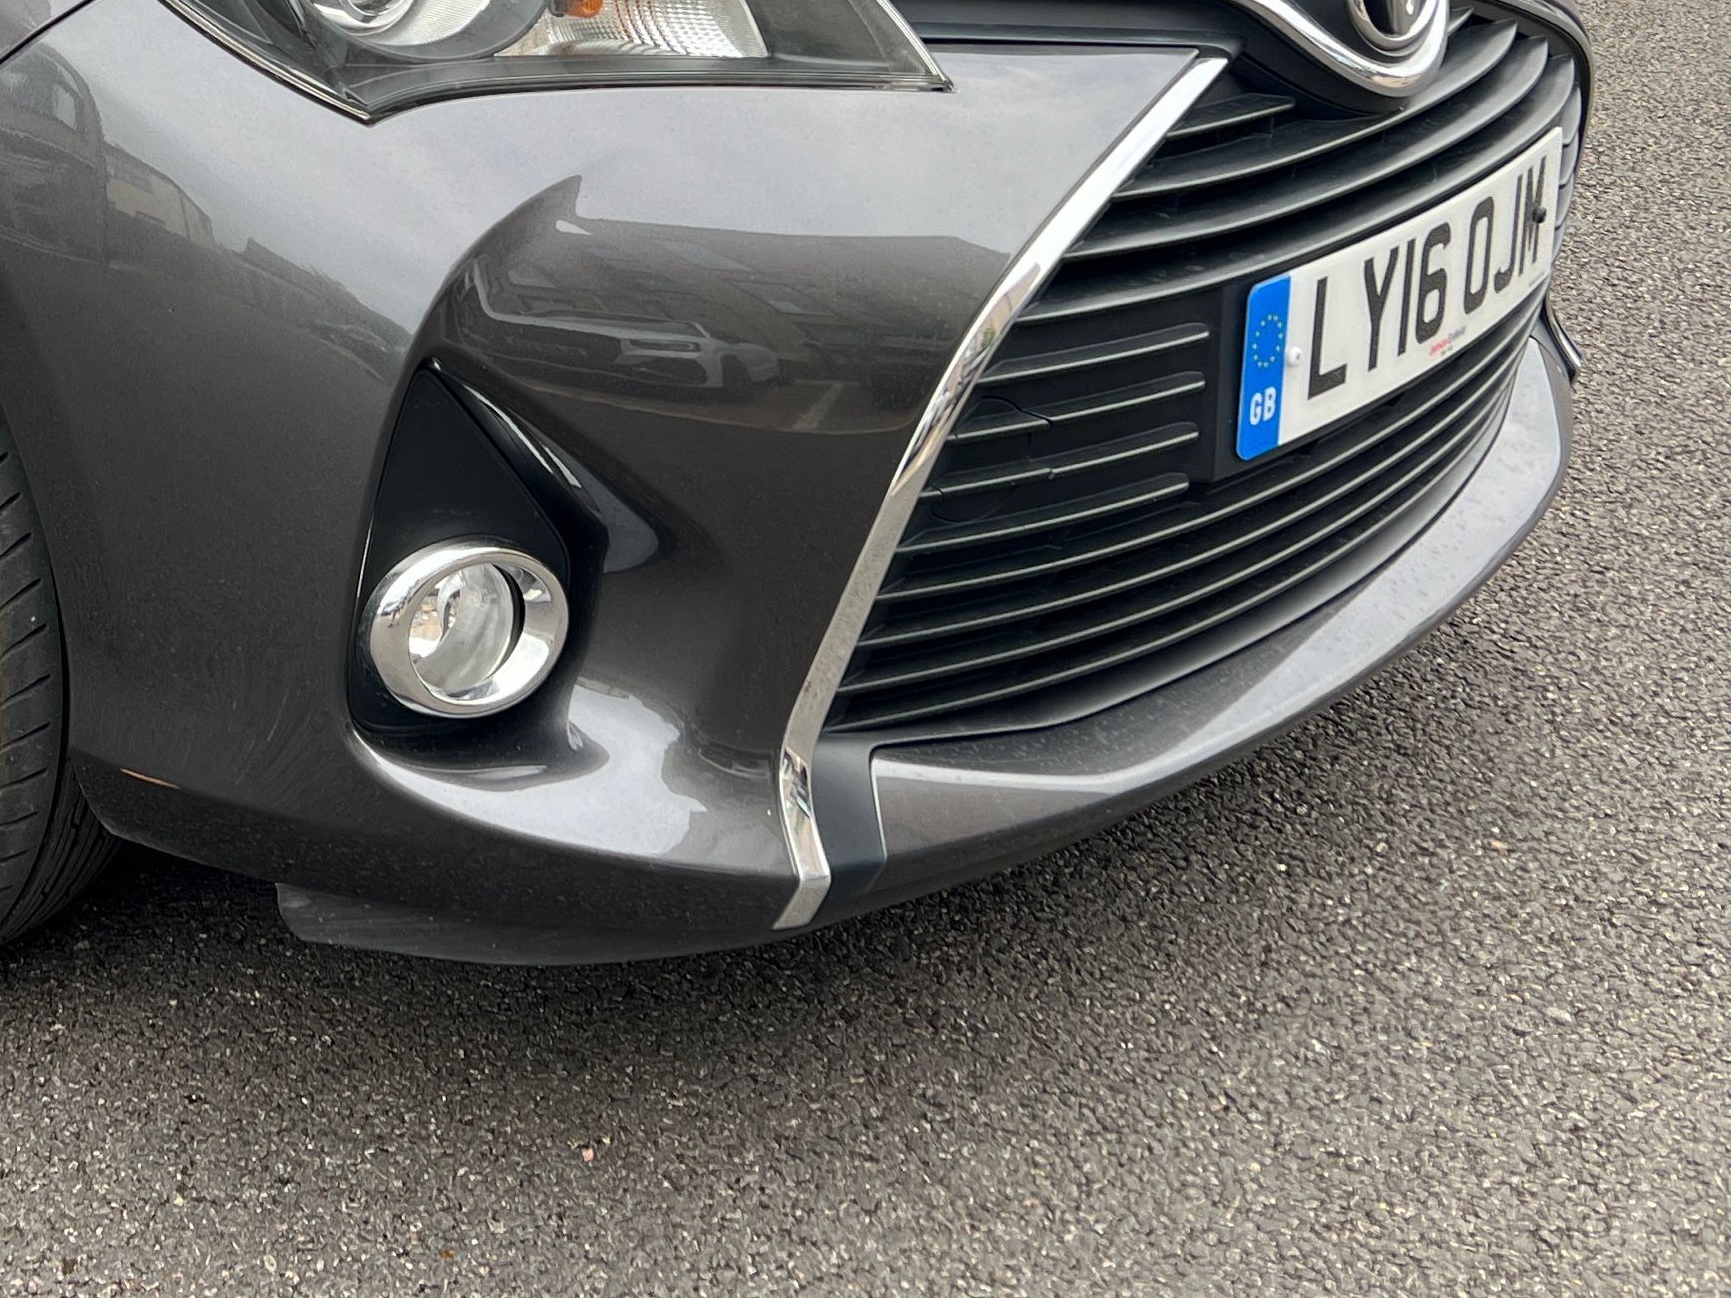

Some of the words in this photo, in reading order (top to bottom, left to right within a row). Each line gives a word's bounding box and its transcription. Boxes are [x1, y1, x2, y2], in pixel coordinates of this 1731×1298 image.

[1308, 221, 1452, 400] LY16
[1463, 155, 1547, 314] OJM
[1250, 387, 1276, 425] GB
